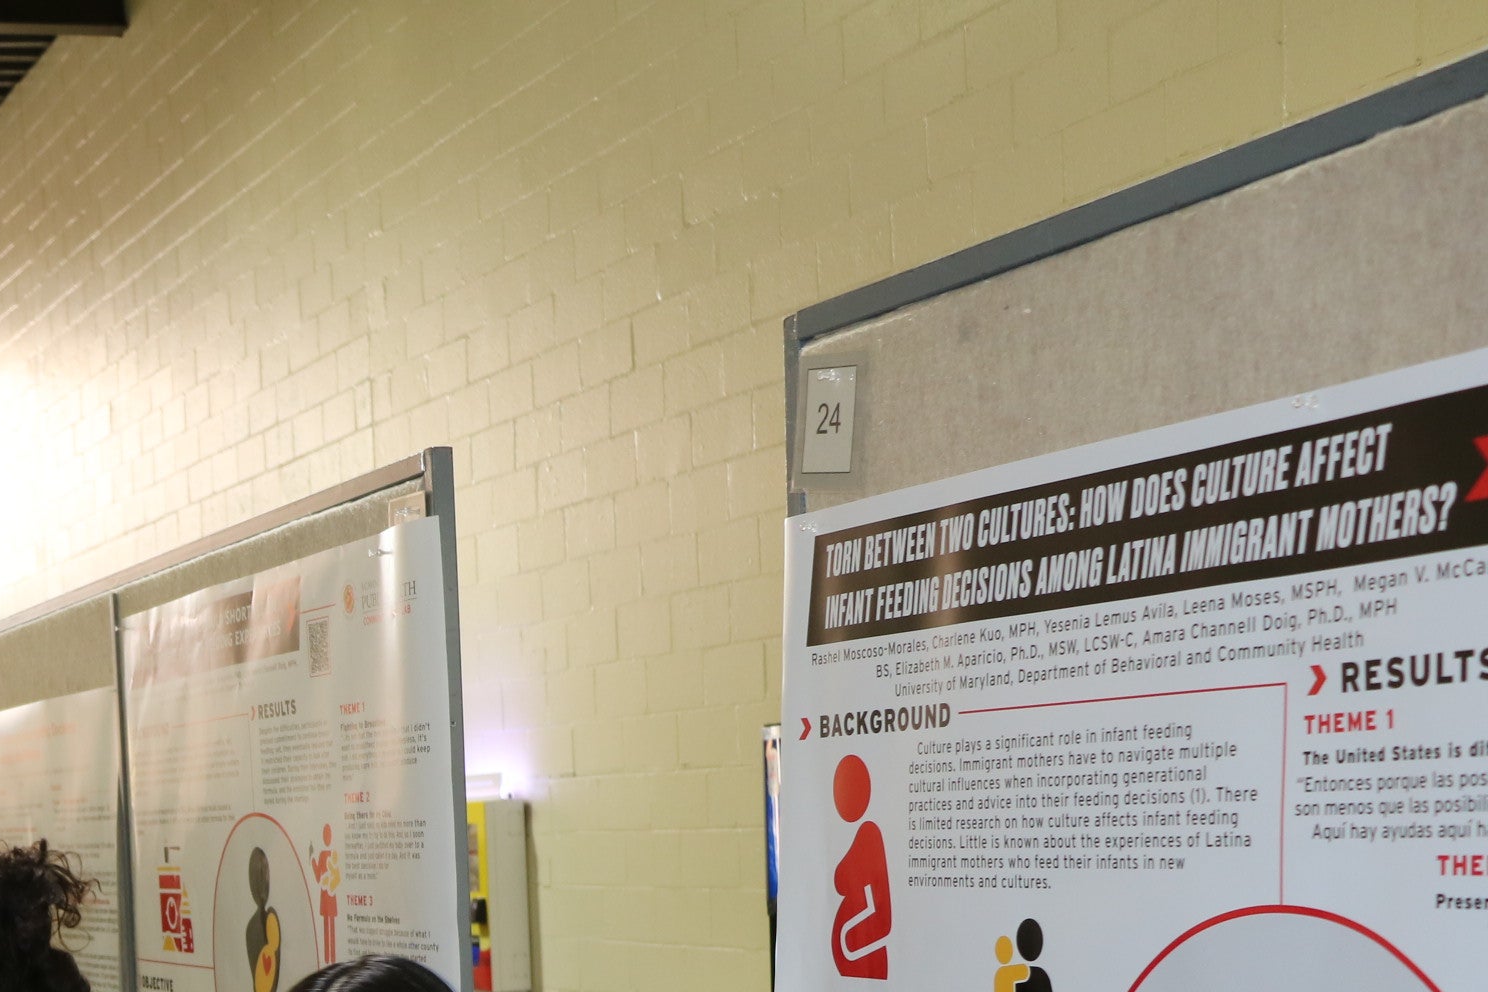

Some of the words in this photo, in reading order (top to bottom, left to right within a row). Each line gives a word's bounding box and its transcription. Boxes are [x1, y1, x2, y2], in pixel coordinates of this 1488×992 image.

[816, 402, 842, 434] 24
[826, 537, 861, 578] TORN
[863, 521, 936, 570] BETWEEN
[939, 512, 974, 557] TWO
[977, 492, 1075, 547] CULTURES:
[1078, 480, 1127, 528] HOW
[1129, 467, 1187, 518] DOES
[1190, 444, 1292, 507] CULTURE
[1293, 422, 1392, 487] AFFECT
[824, 587, 874, 629] INFANT
[875, 575, 939, 620] FEEDING
[941, 558, 1032, 610] DECISIONS
[1034, 546, 1103, 595] AMONG
[1105, 533, 1176, 584] LATINA
[1179, 508, 1314, 572] IMMIGRANT
[1315, 481, 1457, 551] MOTHERS?
[811, 649, 840, 665] Rashel
[843, 638, 928, 661] Moscoso-Morales,
[932, 632, 975, 649] Charlene
[979, 627, 1004, 641] Kuo,
[1008, 621, 1038, 638] MPH,
[1044, 614, 1089, 633] Yesenia
[1094, 610, 1136, 627] Lemus
[1141, 602, 1177, 620] Avila,
[1183, 597, 1224, 615] Leena
[1231, 590, 1284, 607] Moses,
[1291, 579, 1341, 599] MSPH,
[1354, 572, 1407, 593] Megan
[1414, 565, 1428, 583] V.
[876, 663, 892, 678] BS,
[895, 657, 939, 675] Elizabeth
[943, 655, 953, 668] M.
[957, 648, 1006, 668] Aparicio,
[1010, 644, 1043, 660] Ph.D.,
[1048, 638, 1079, 656] MSW,
[1084, 631, 1136, 652] LCSW-C,
[1142, 628, 1184, 644] Amara
[1190, 616, 1255, 639] Channell
[1262, 612, 1301, 632] Doig,
[1307, 604, 1352, 624] Ph.D.,
[1359, 598, 1396, 617] MPH
[894, 679, 942, 697] University
[946, 675, 956, 690] of
[959, 670, 1013, 690] Maryland,
[1018, 661, 1089, 683] Department
[1094, 658, 1106, 675] of
[1111, 650, 1180, 673] Behavioral
[1186, 647, 1211, 665] and
[1217, 638, 1305, 661] Community
[1311, 631, 1363, 651] Health
[258, 700, 296, 719] RESULTS
[340, 703, 360, 715] THEME
[819, 702, 950, 738] BACKGROUND
[1304, 709, 1376, 734] THEME
[1386, 708, 1393, 728] 1
[917, 741, 952, 755] Culture
[955, 739, 982, 755] plays
[985, 739, 991, 750] a
[994, 732, 1054, 752] significant
[1058, 730, 1081, 745] role
[1086, 728, 1096, 743] in
[1101, 726, 1137, 742] infant
[1142, 723, 1192, 740] feeding
[1302, 750, 1328, 765] The
[1336, 746, 1384, 764] United
[1392, 745, 1440, 761] States
[1448, 742, 1461, 758] is
[908, 759, 955, 774] decisions.
[959, 755, 1012, 773] Immigrant
[1016, 752, 1063, 767] mothers
[1068, 751, 1096, 765] have
[1100, 749, 1113, 763] to
[1118, 745, 1174, 764] navigate
[1179, 741, 1236, 760] multiple
[344, 792, 364, 804] THEME
[347, 895, 367, 906] THEME
[142, 976, 173, 992] OBJECTIVE
